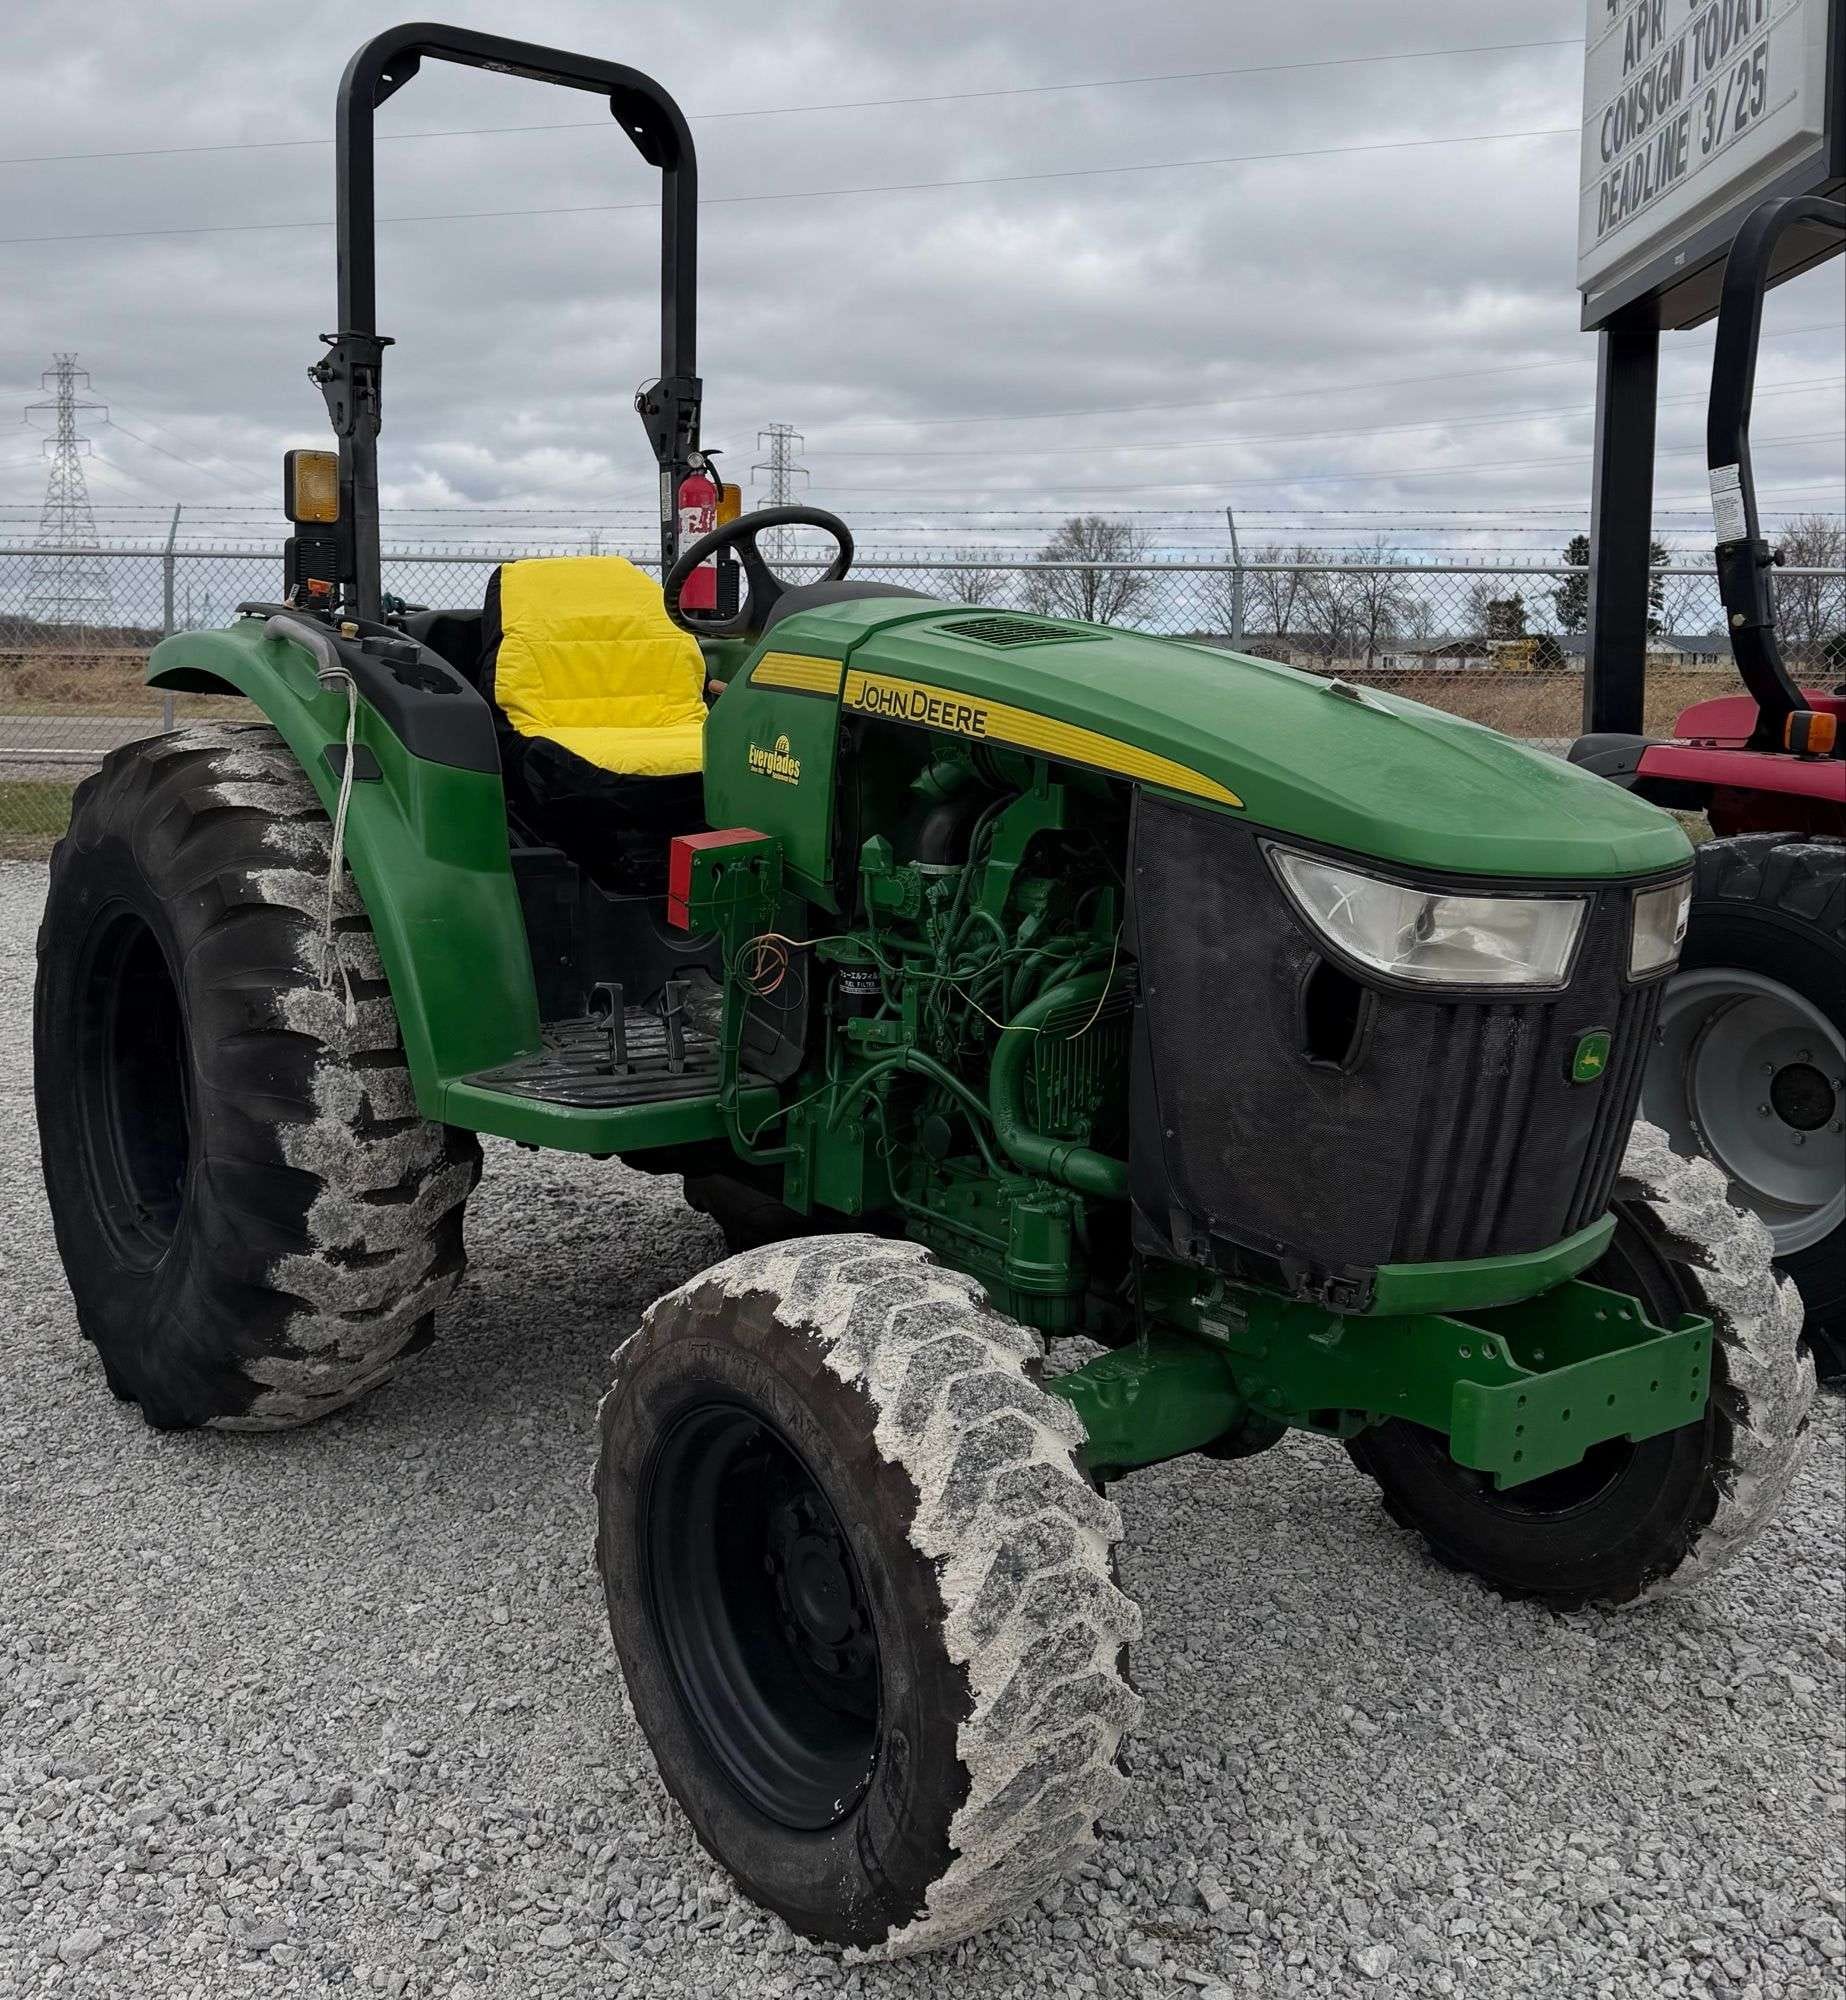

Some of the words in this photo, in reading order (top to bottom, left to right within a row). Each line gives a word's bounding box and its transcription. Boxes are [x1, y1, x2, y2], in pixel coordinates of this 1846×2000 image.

[1623, 0, 1664, 77] APR
[1597, 110, 1689, 238] DEADLINE
[1702, 40, 1767, 155] 3/25
[1601, 38, 1686, 163] CONSIGN
[855, 680, 908, 717] JOHN
[910, 690, 988, 734] DEERE
[749, 743, 800, 778] Everglades
